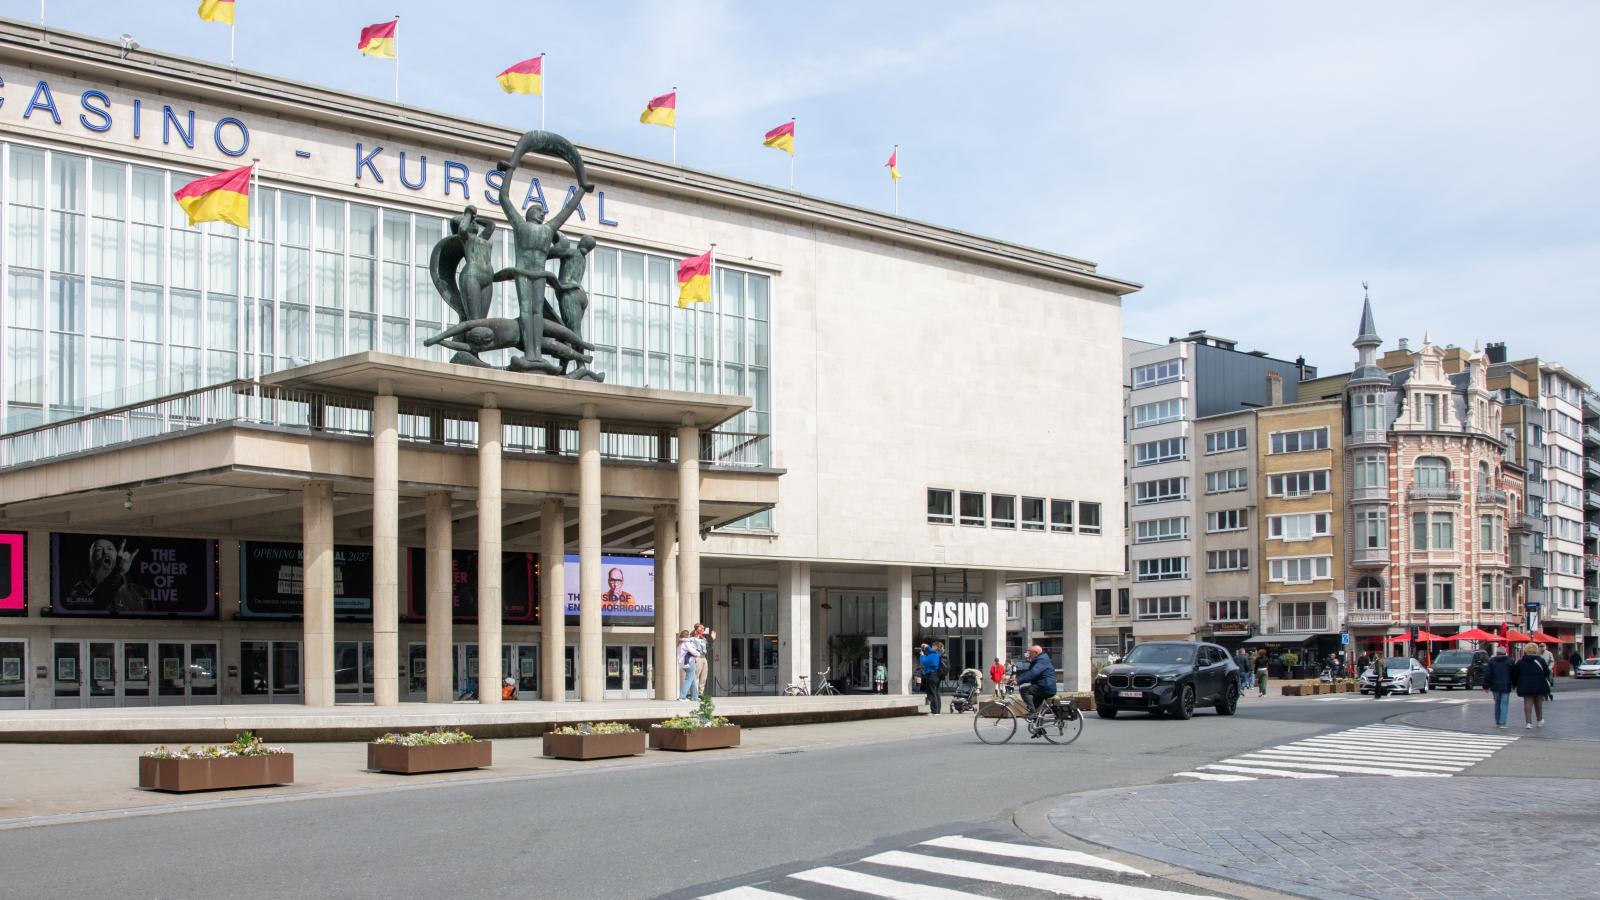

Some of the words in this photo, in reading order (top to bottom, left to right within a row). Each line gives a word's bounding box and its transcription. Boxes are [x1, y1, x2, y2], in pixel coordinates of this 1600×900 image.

[0, 76, 250, 157] ASINO
[151, 549, 176, 561] THE
[253, 549, 296, 559] OPENING
[140, 562, 187, 575] POWER
[154, 575, 175, 588] OF
[151, 589, 178, 601] LIVE
[568, 593, 580, 601] TH
[919, 601, 989, 628] CASINO
